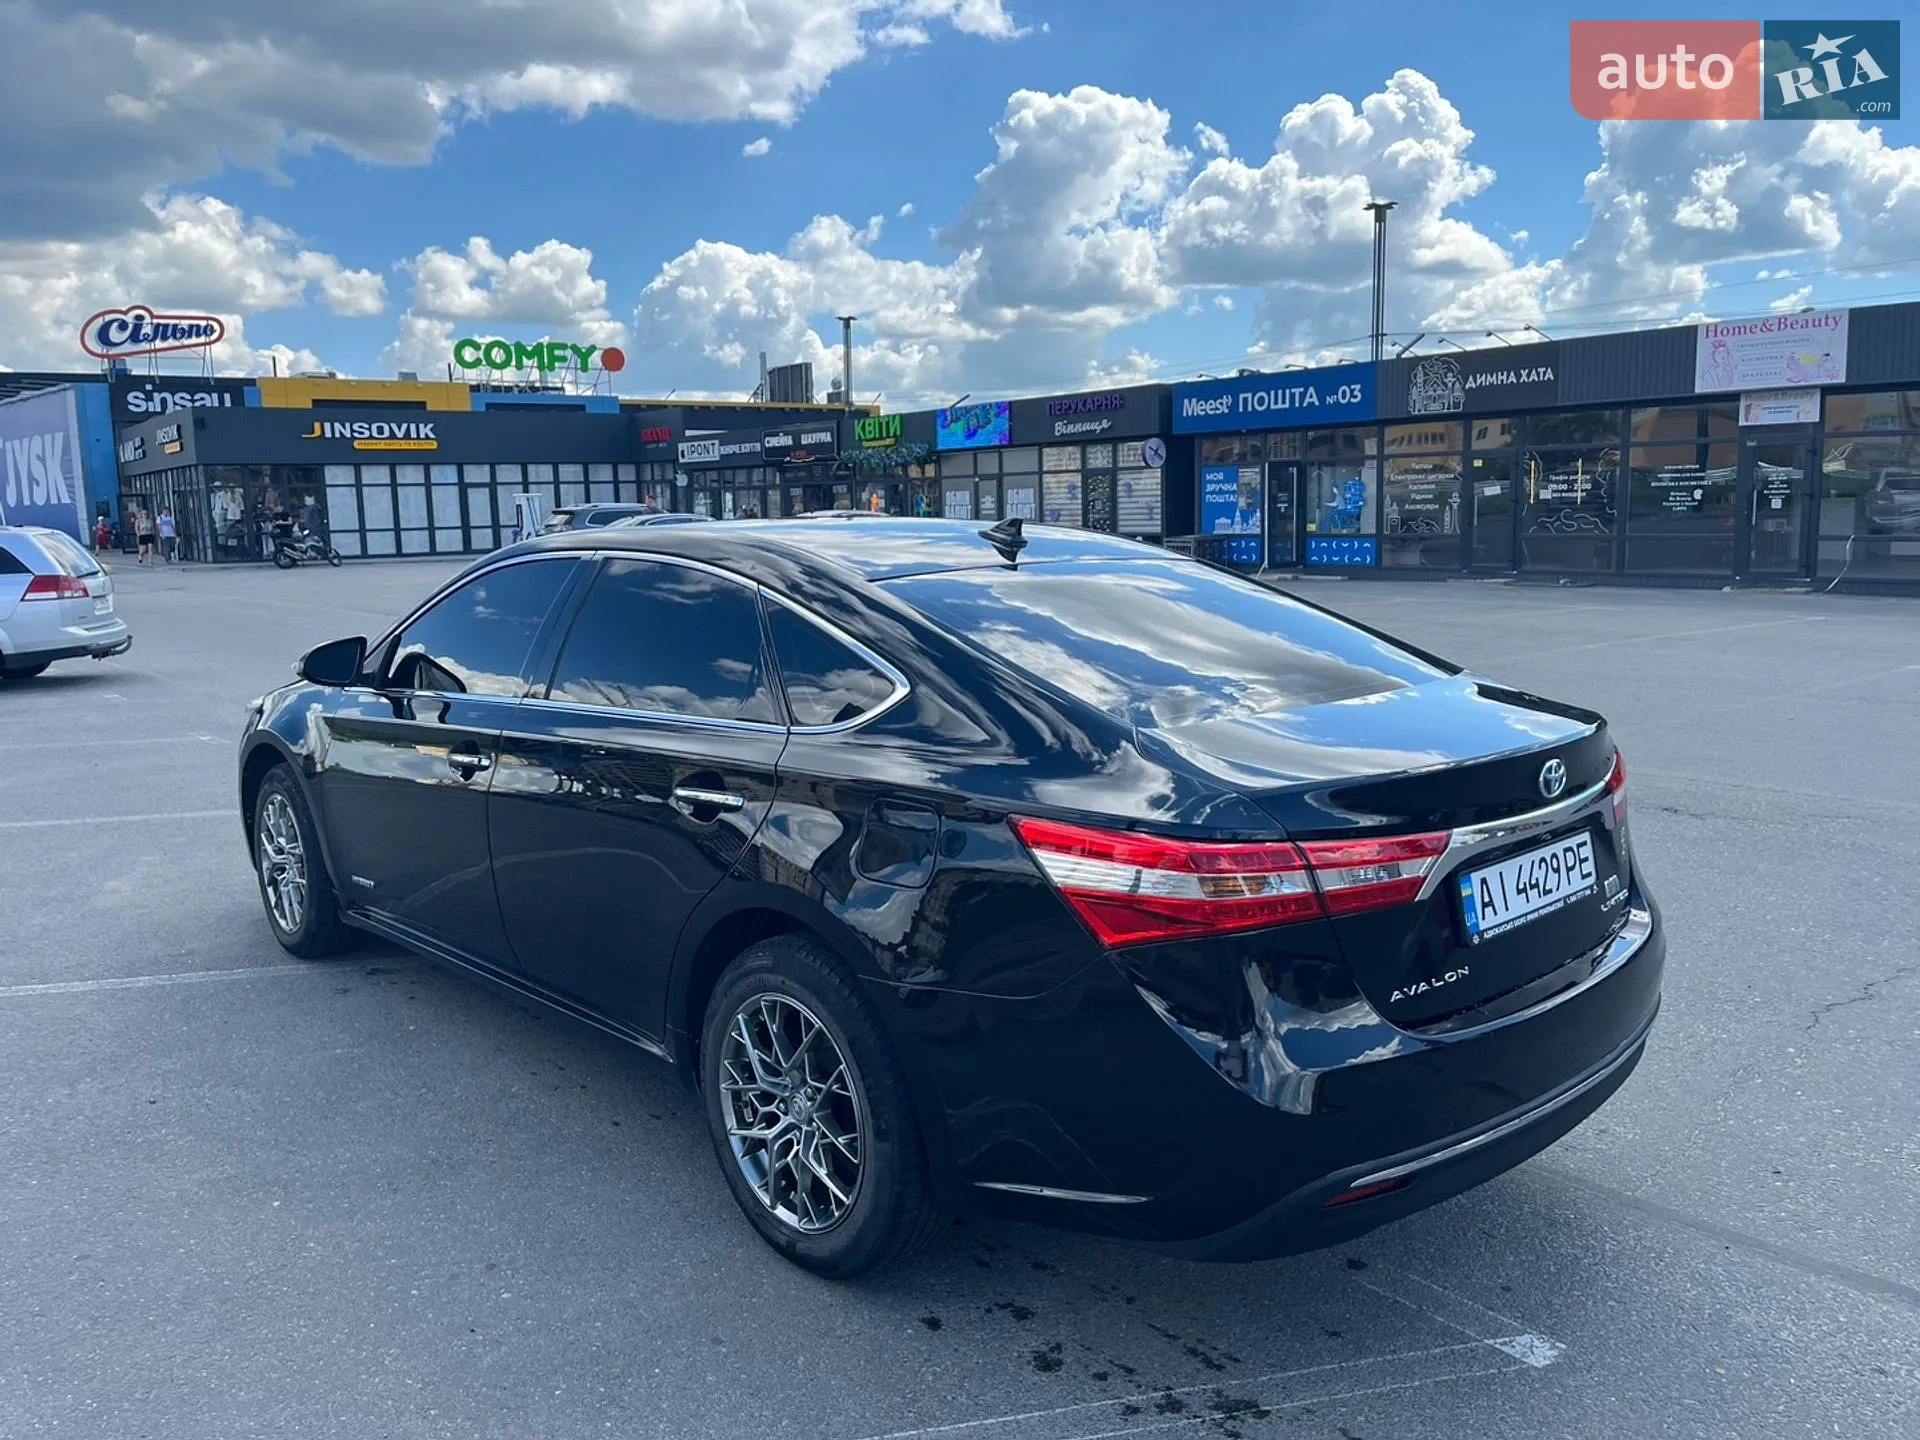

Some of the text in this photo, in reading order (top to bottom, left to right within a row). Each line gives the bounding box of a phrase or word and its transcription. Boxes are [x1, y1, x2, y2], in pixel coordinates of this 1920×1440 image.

[98, 314, 217, 347] Сільпо
[1704, 313, 1843, 339] Home&Beauty
[453, 338, 598, 373] COMFY
[1465, 367, 1555, 390] ДИМНА ХАТА
[1047, 393, 1121, 415] ПЕРУКАРНЯ
[1183, 396, 1229, 417] Meest
[1239, 386, 1320, 412] ПОШТА
[301, 421, 437, 439] JINSOVIK
[854, 415, 900, 440] КВІТИ
[1054, 419, 1112, 436] Вінниця
[5, 432, 71, 508] JYSK
[1480, 870, 1509, 921] AI
[1516, 851, 1561, 904] 4429
[1562, 840, 1593, 886] PE
[1389, 966, 1470, 1002] AVALON
